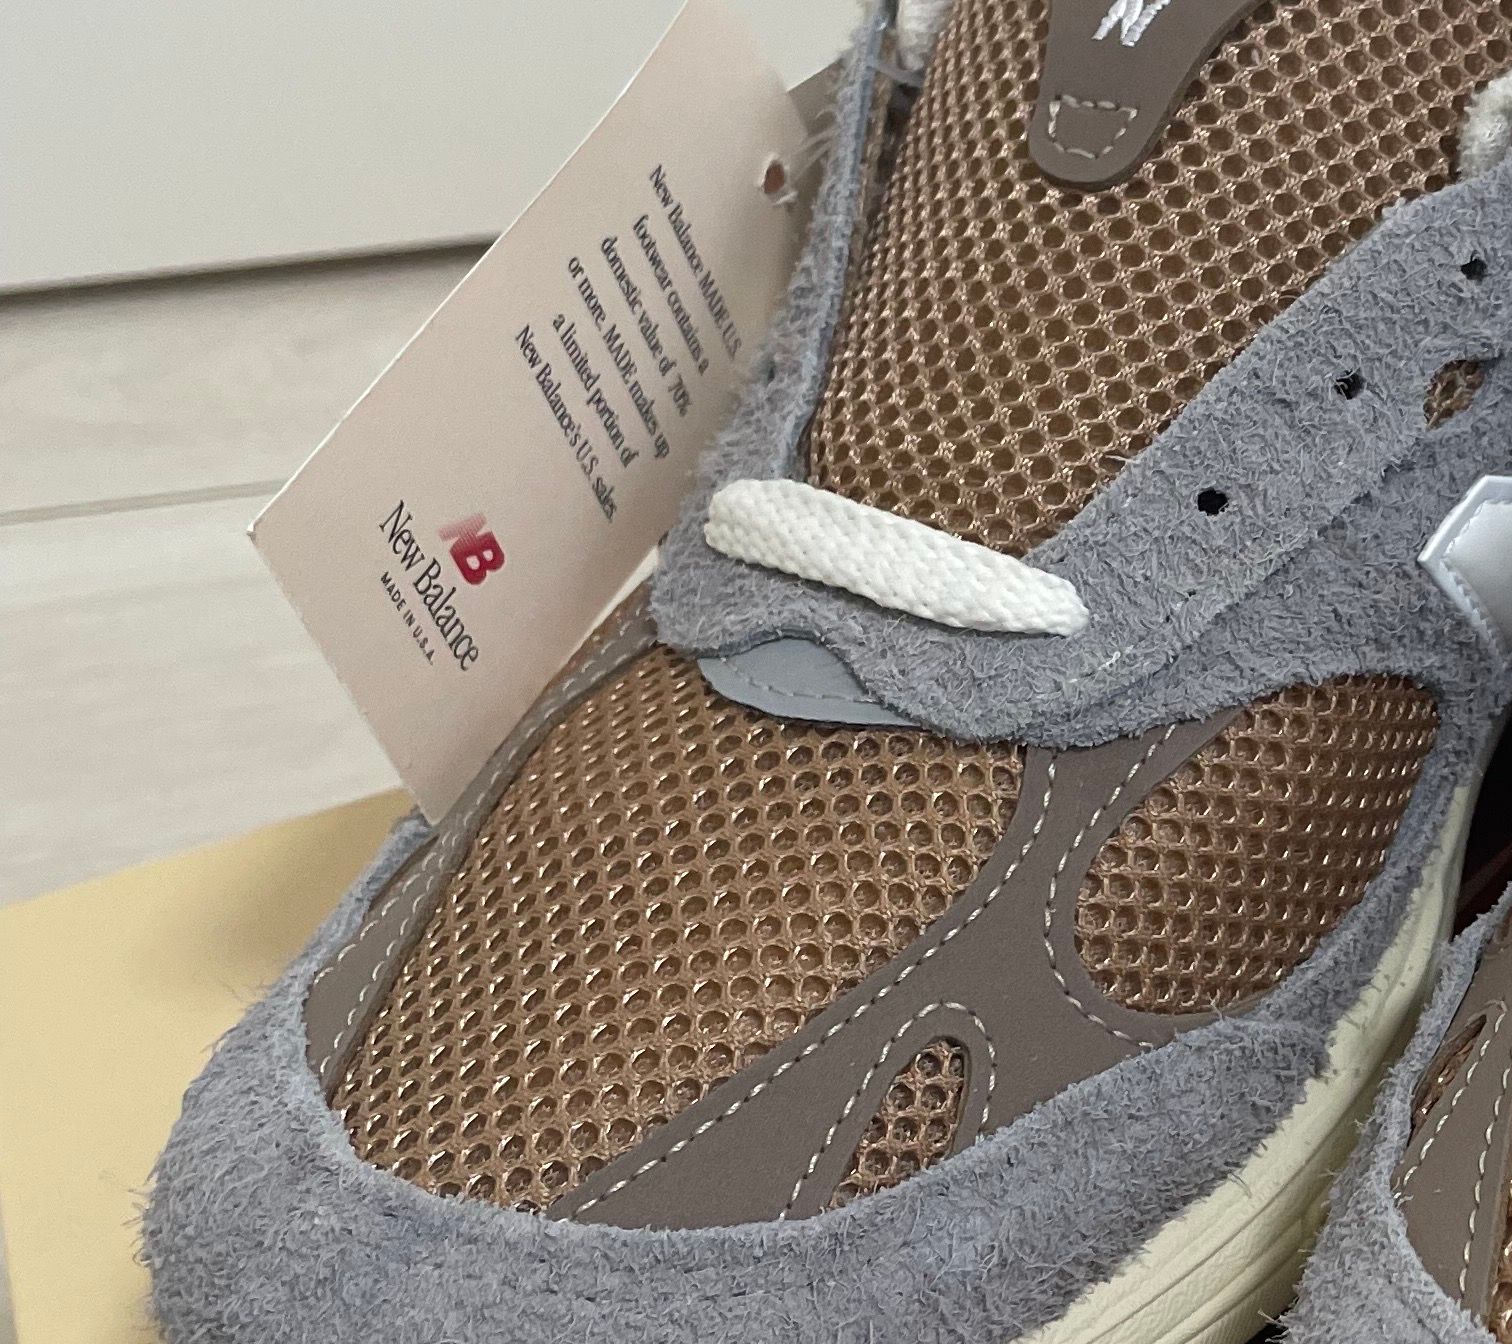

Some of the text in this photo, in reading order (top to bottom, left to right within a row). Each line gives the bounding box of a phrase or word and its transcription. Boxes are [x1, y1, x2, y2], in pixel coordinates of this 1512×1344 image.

[632, 214, 673, 291] footwear
[667, 290, 708, 363] contains
[649, 164, 673, 207] New
[667, 202, 703, 276] Balance
[568, 256, 585, 280] or
[602, 323, 638, 385] MADE
[628, 379, 657, 436] makes
[654, 432, 670, 460] up
[601, 236, 643, 315] domestic
[638, 310, 663, 358] value
[658, 359, 677, 377] of
[515, 323, 543, 369] New
[535, 362, 582, 448] Balance's
[552, 313, 640, 468] a limited portion of
[379, 499, 479, 671] New Balance
[380, 571, 407, 611] MADE
[403, 609, 416, 627] IN
